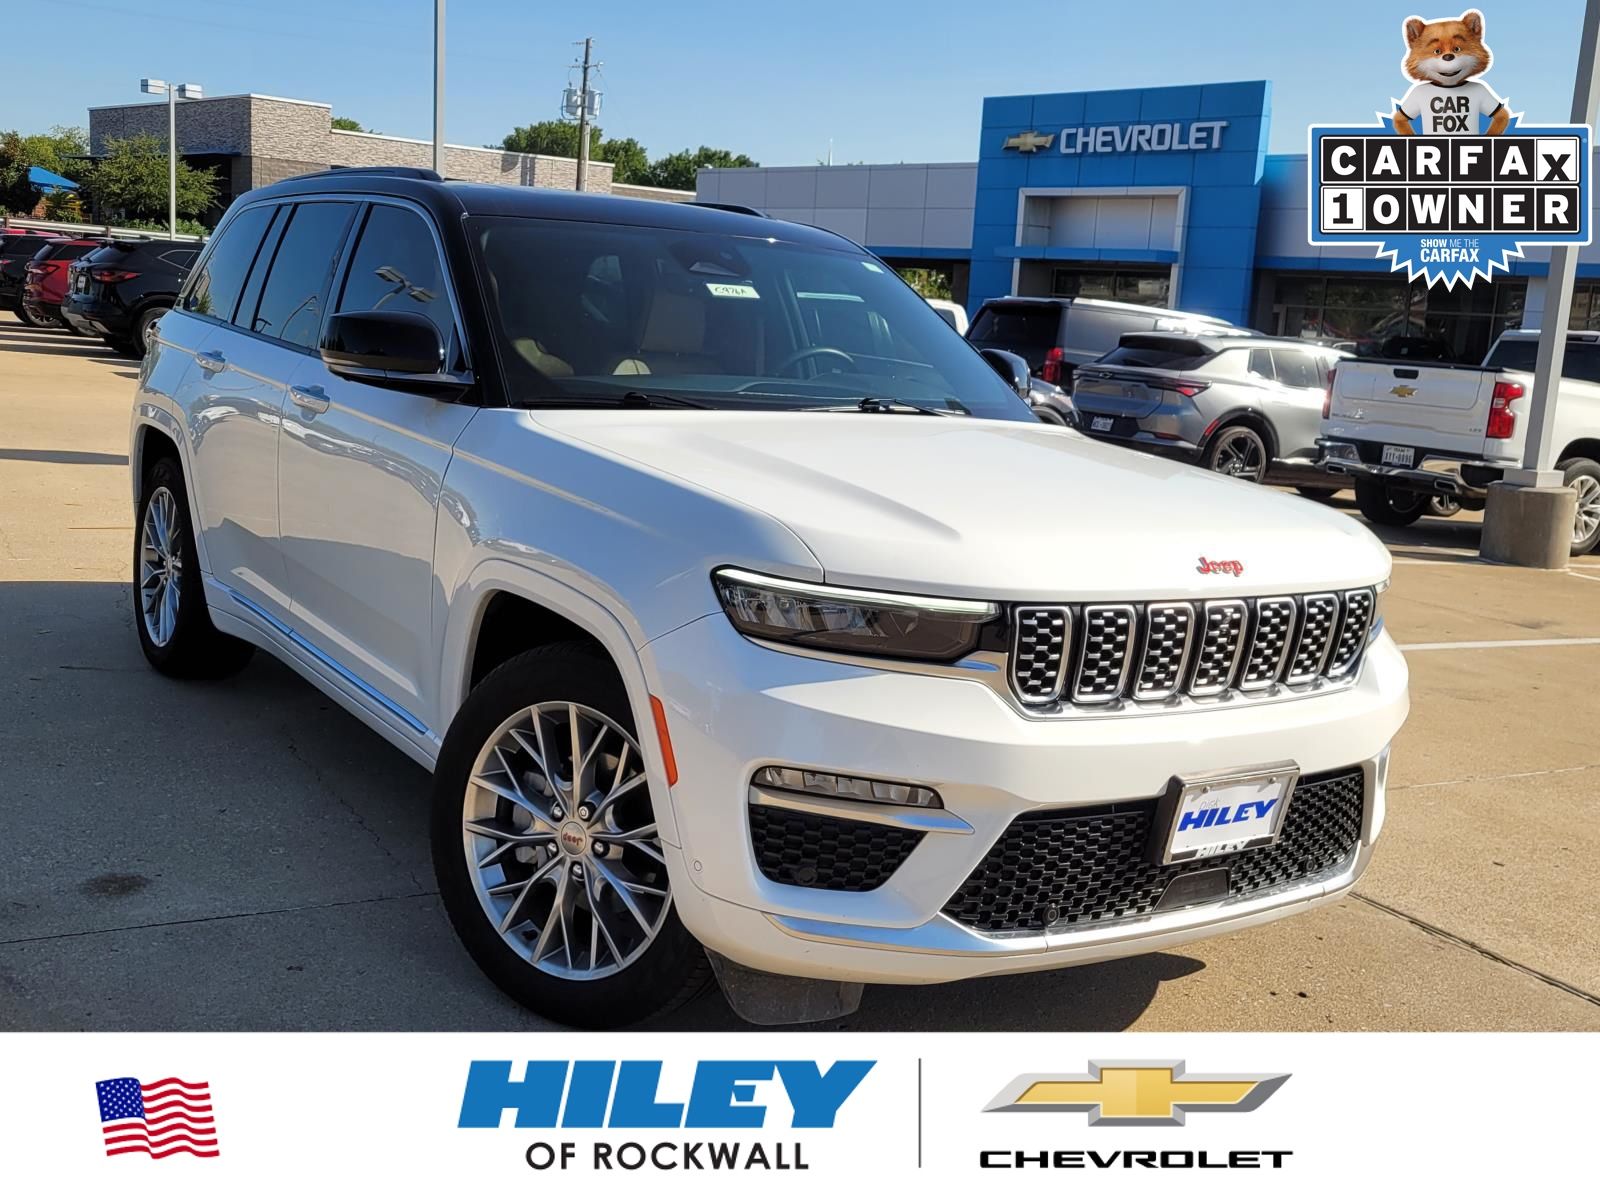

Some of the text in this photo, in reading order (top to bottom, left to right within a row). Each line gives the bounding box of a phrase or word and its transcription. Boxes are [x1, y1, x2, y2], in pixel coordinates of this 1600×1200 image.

[1060, 120, 1230, 154] CHEVROLET
[1196, 556, 1243, 578] Jeep
[1177, 798, 1279, 832] HILEY
